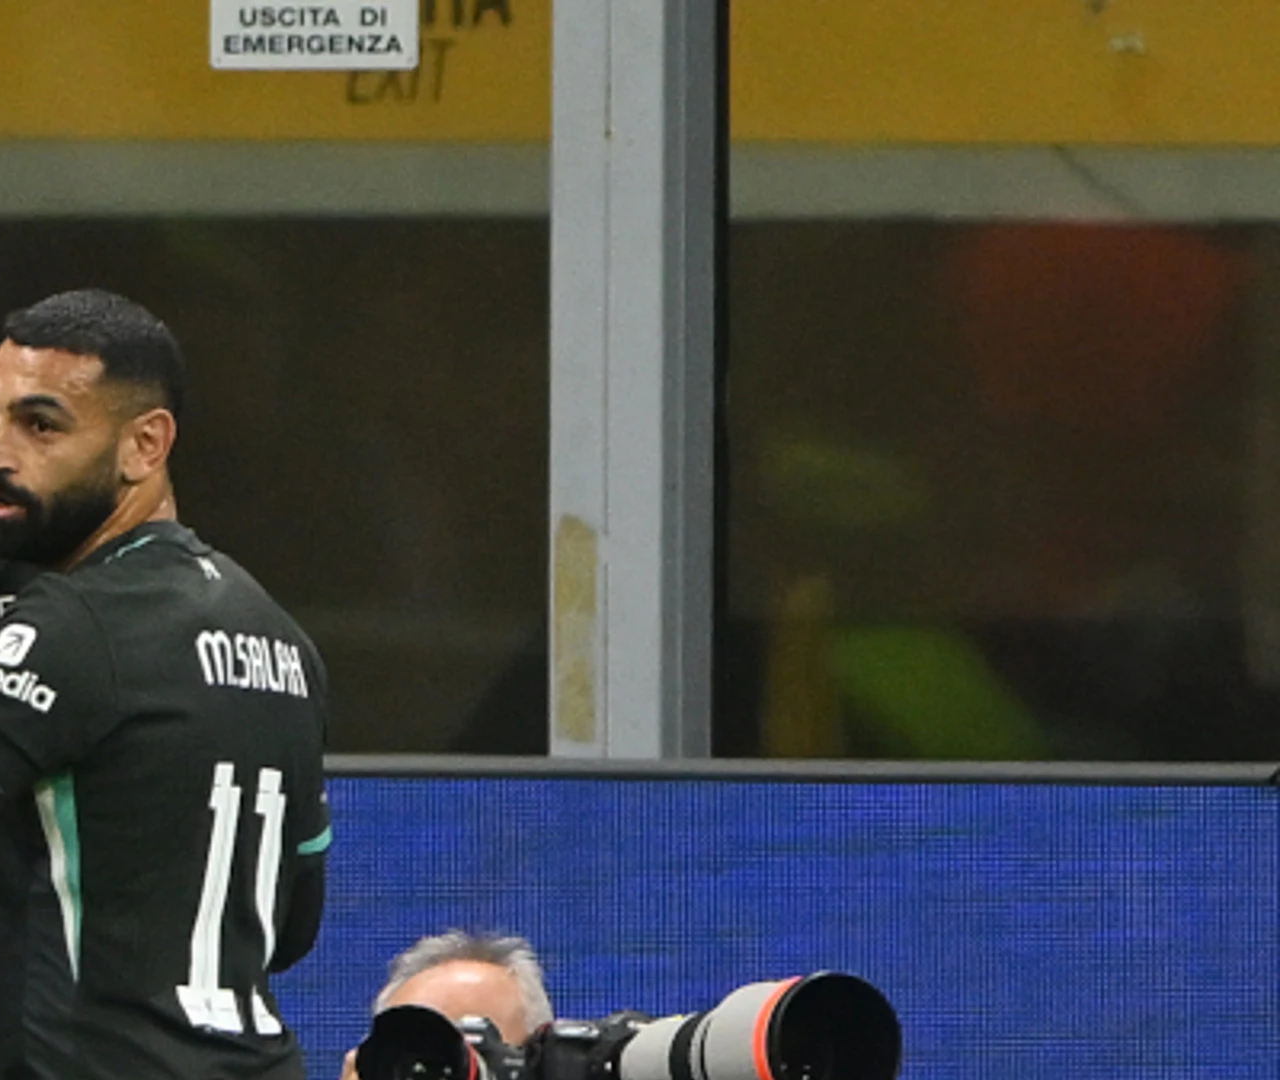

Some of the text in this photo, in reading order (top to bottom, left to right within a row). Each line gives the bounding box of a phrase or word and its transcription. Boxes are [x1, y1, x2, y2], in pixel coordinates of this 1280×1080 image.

[238, 6, 388, 28] USCITA DI
[223, 34, 404, 55] EMERGENZA
[175, 761, 287, 1035] 11
